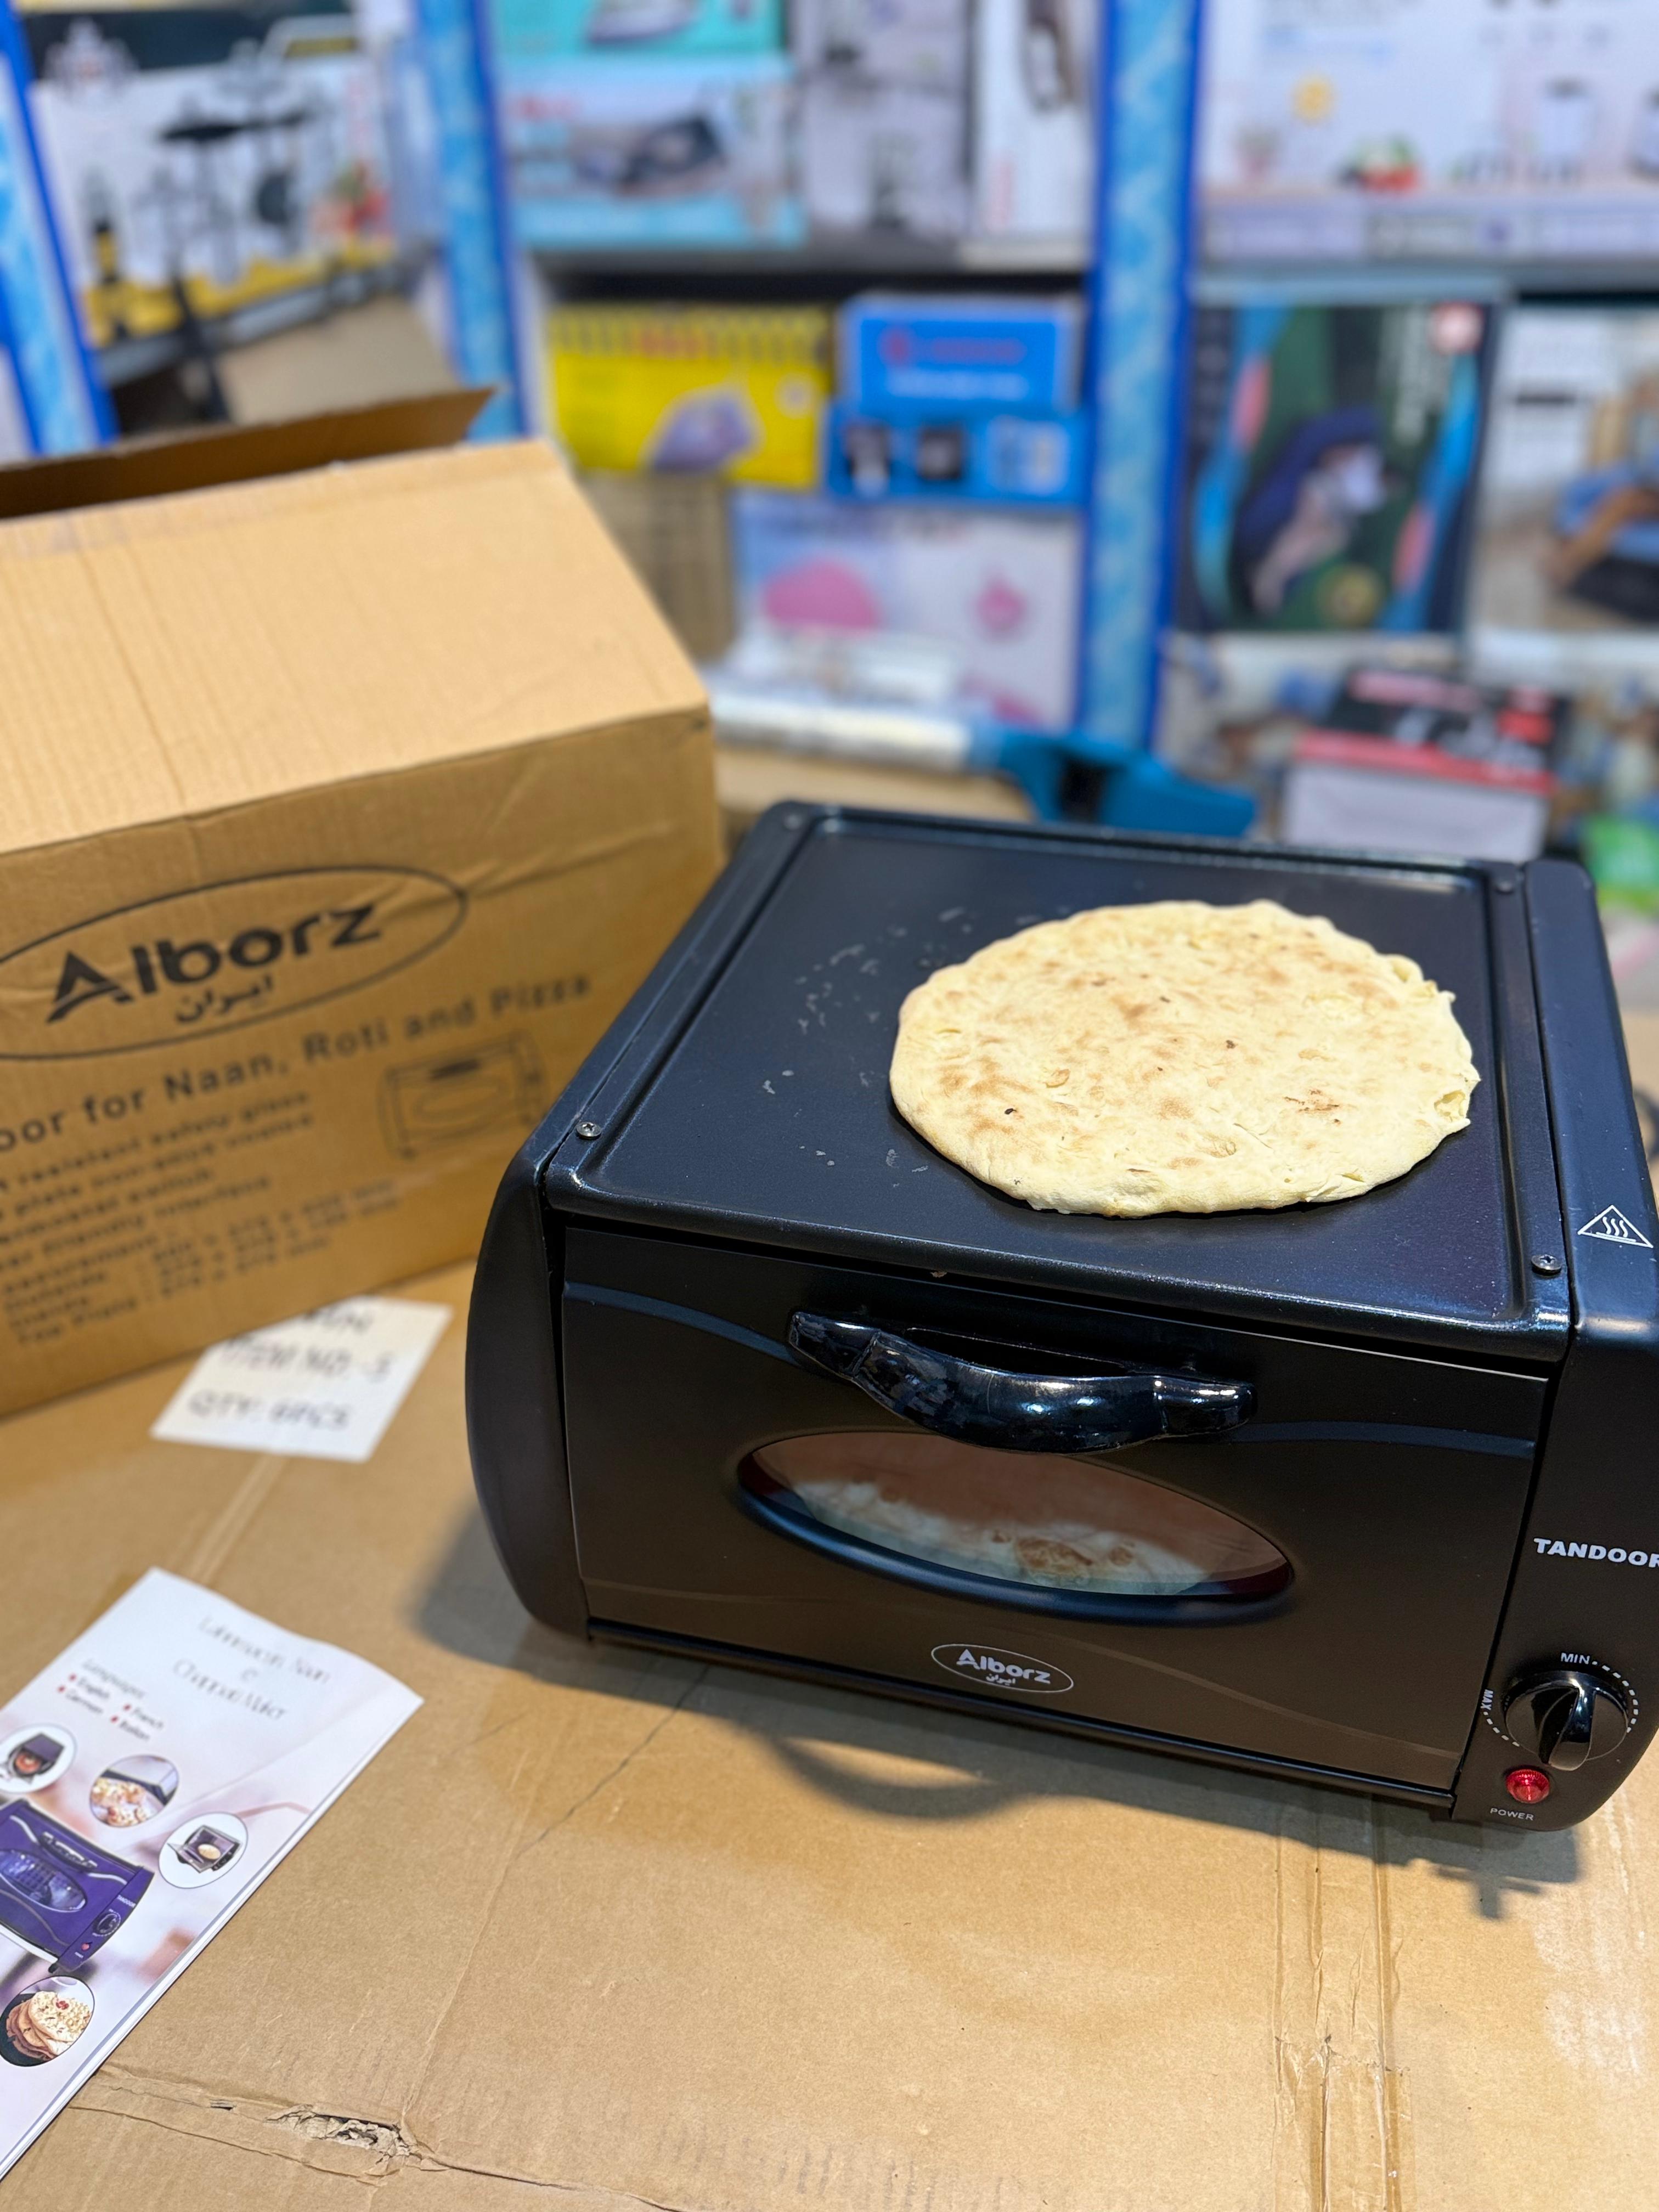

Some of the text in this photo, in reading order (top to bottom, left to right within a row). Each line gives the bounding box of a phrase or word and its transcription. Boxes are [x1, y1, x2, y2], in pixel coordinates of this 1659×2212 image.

[46, 902, 382, 1024] Alborz
[82, 1089, 146, 1125] for
[162, 1053, 289, 1103] Naan,
[302, 1019, 388, 1064] Roti
[403, 997, 476, 1039] and
[490, 974, 590, 1018] Pizza
[1533, 1537, 1659, 1568] TANDOOR
[956, 1649, 1051, 1684] Alborz
[1560, 1652, 1591, 1664] MIN
[64, 1688, 105, 1716] German
[1480, 1689, 1493, 1711] MAX
[131, 1705, 165, 1731] French
[1489, 1807, 1534, 1820] POWER
